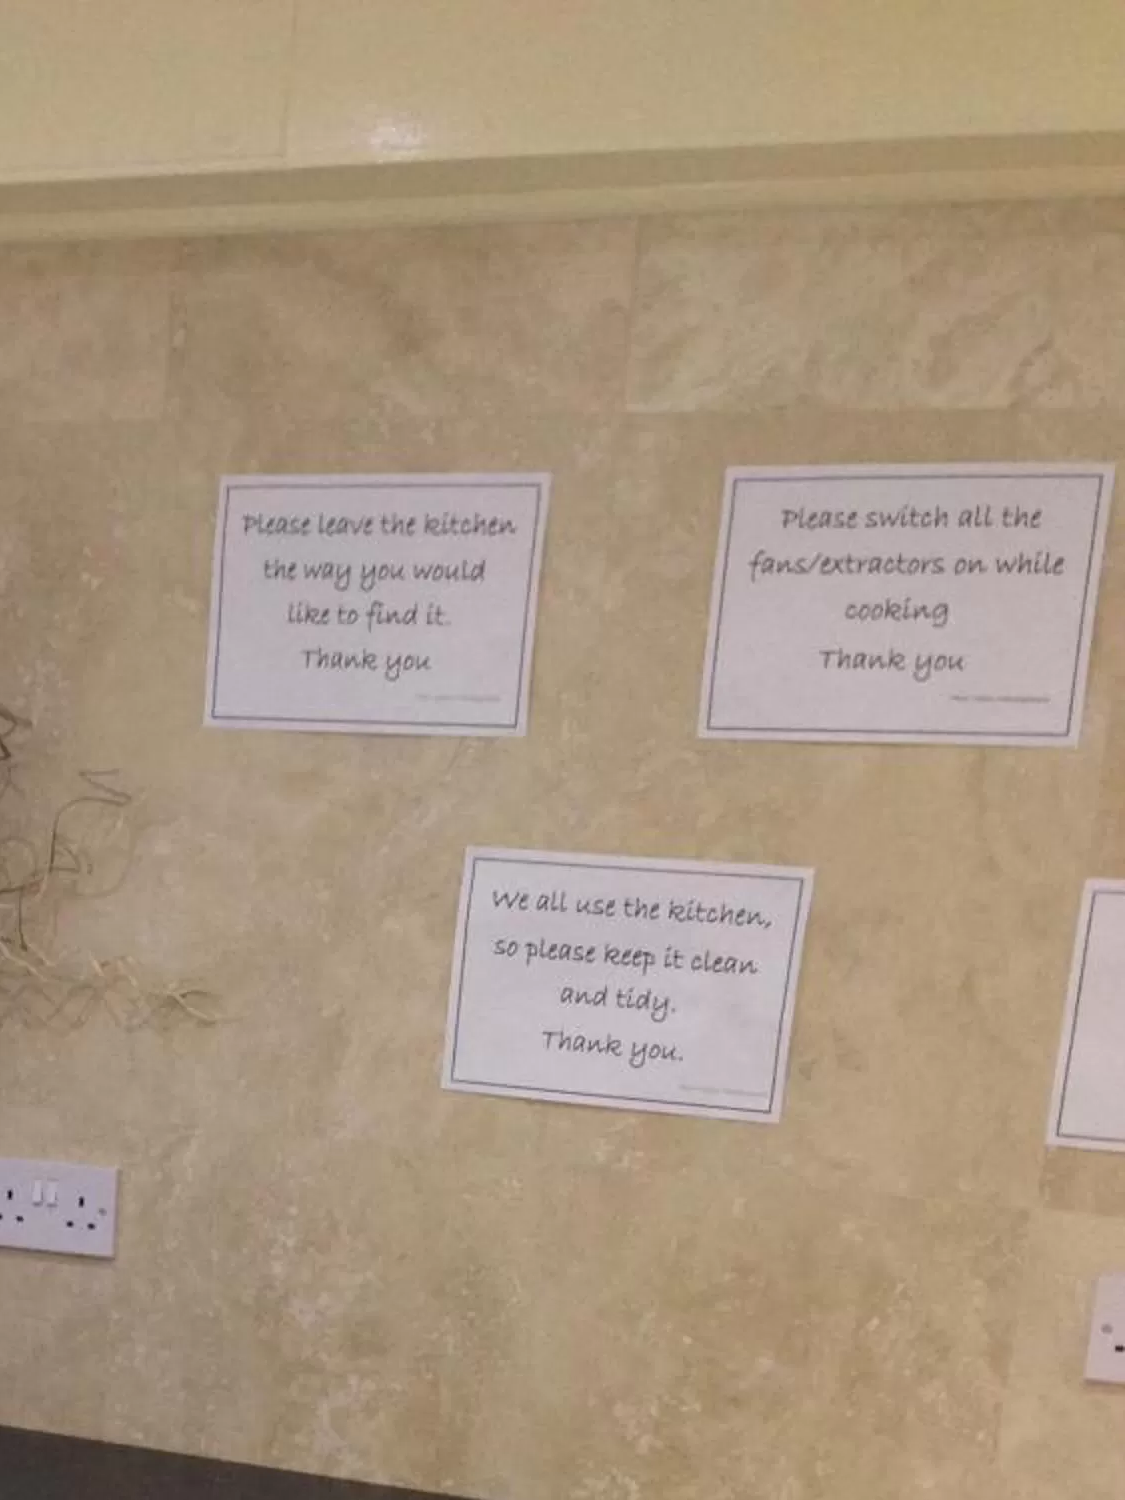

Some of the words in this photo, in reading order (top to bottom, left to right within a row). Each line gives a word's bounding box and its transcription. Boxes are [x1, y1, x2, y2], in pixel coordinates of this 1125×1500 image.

[242, 512, 311, 537] Please
[318, 512, 373, 535] leave
[381, 513, 415, 536] the
[423, 512, 517, 536] kitchen
[781, 507, 858, 530] Please
[864, 504, 949, 528] switch
[958, 505, 992, 528] all
[1002, 506, 1043, 528] the
[264, 559, 297, 581] the
[304, 563, 351, 592] way
[361, 563, 405, 592] you
[414, 560, 487, 582] would
[748, 549, 945, 583] fans/extractors
[954, 557, 988, 576] on
[996, 550, 1065, 576] while
[287, 601, 330, 625] like
[337, 605, 358, 626] to
[365, 601, 418, 633] find
[845, 598, 950, 628] cooking
[303, 648, 378, 671] Thank
[384, 653, 431, 682] you
[819, 647, 906, 671] Thank
[913, 654, 965, 682] you
[492, 890, 528, 911] We
[535, 891, 567, 913] all
[576, 898, 615, 917] use
[624, 898, 660, 920] the
[667, 899, 772, 929] kitchen,
[494, 939, 518, 956] so
[525, 939, 595, 966] please
[603, 943, 656, 976] keep
[663, 945, 683, 970] it
[690, 950, 760, 975] clean
[560, 985, 607, 1007] and
[616, 988, 676, 1023] tidy.
[542, 1029, 622, 1056] Thank
[629, 1041, 684, 1068] you.
